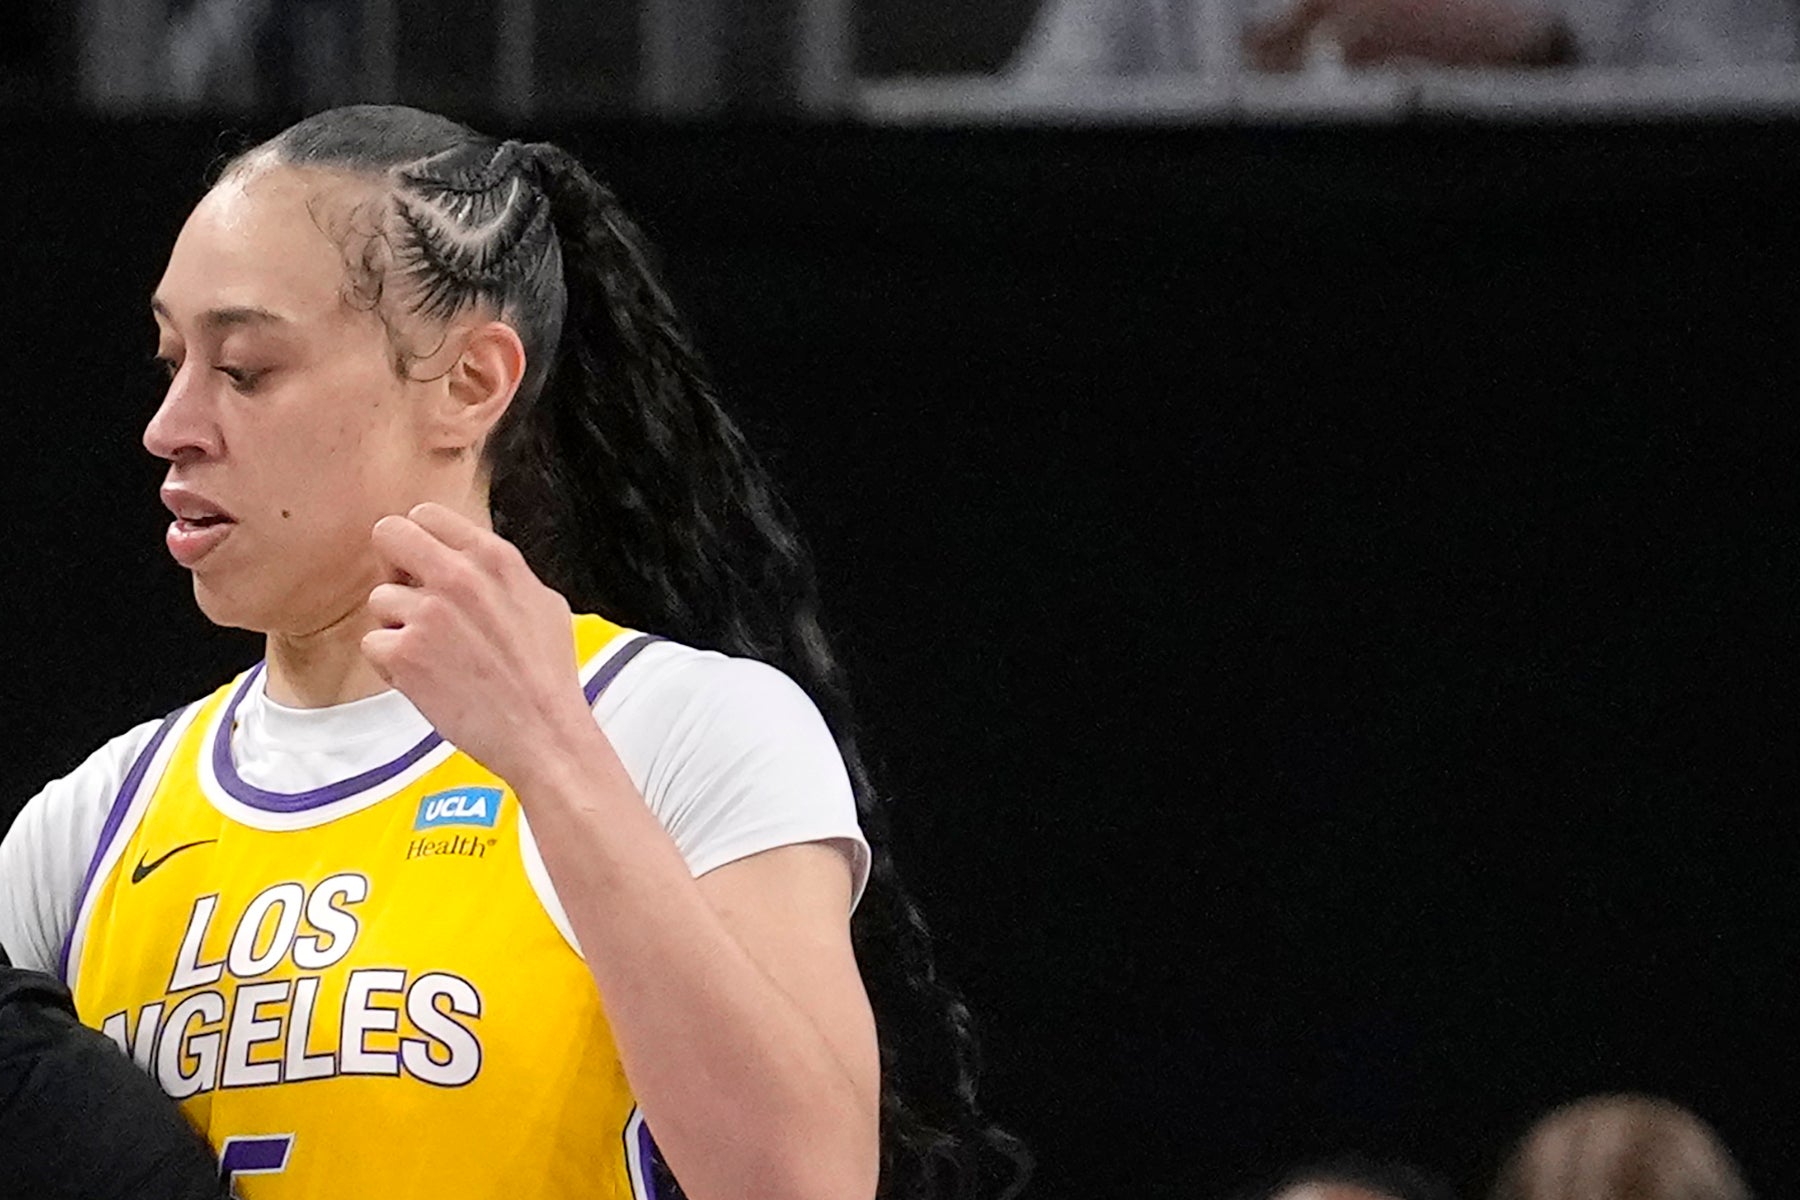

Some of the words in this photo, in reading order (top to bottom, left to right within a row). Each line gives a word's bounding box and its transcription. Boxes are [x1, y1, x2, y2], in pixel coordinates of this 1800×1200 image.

[425, 795, 487, 822] UCLA
[164, 872, 368, 995] LOS
[102, 969, 482, 1100] NGELES
